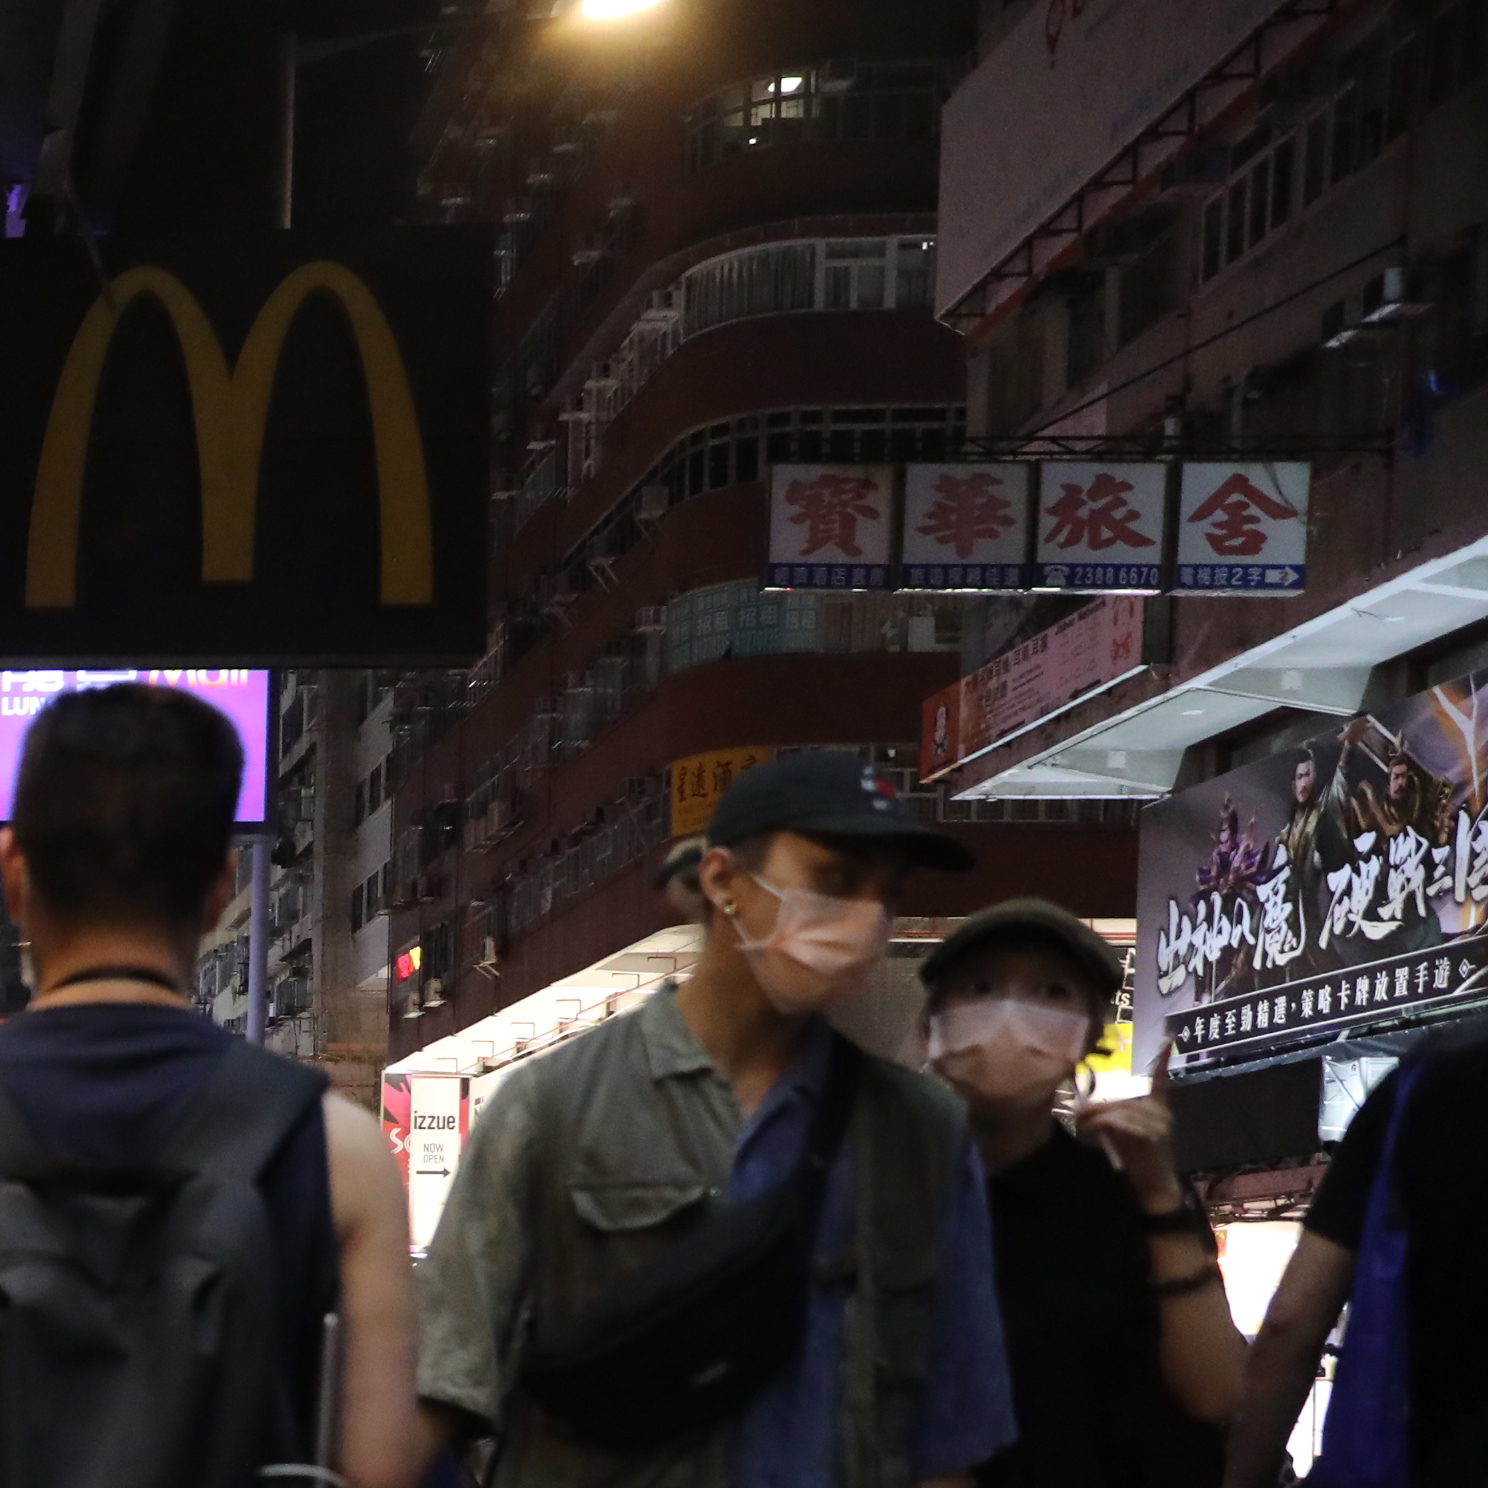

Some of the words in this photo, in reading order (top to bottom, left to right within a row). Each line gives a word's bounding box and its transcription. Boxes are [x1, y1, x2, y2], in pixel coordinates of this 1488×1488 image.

[785, 472, 1299, 559] 寶華旅舍
[1074, 566, 1114, 585] 2388
[1118, 566, 1159, 585] 6670
[413, 1110, 456, 1130] izzue
[423, 1143, 444, 1154] NOW
[423, 1154, 445, 1164] OPEN
